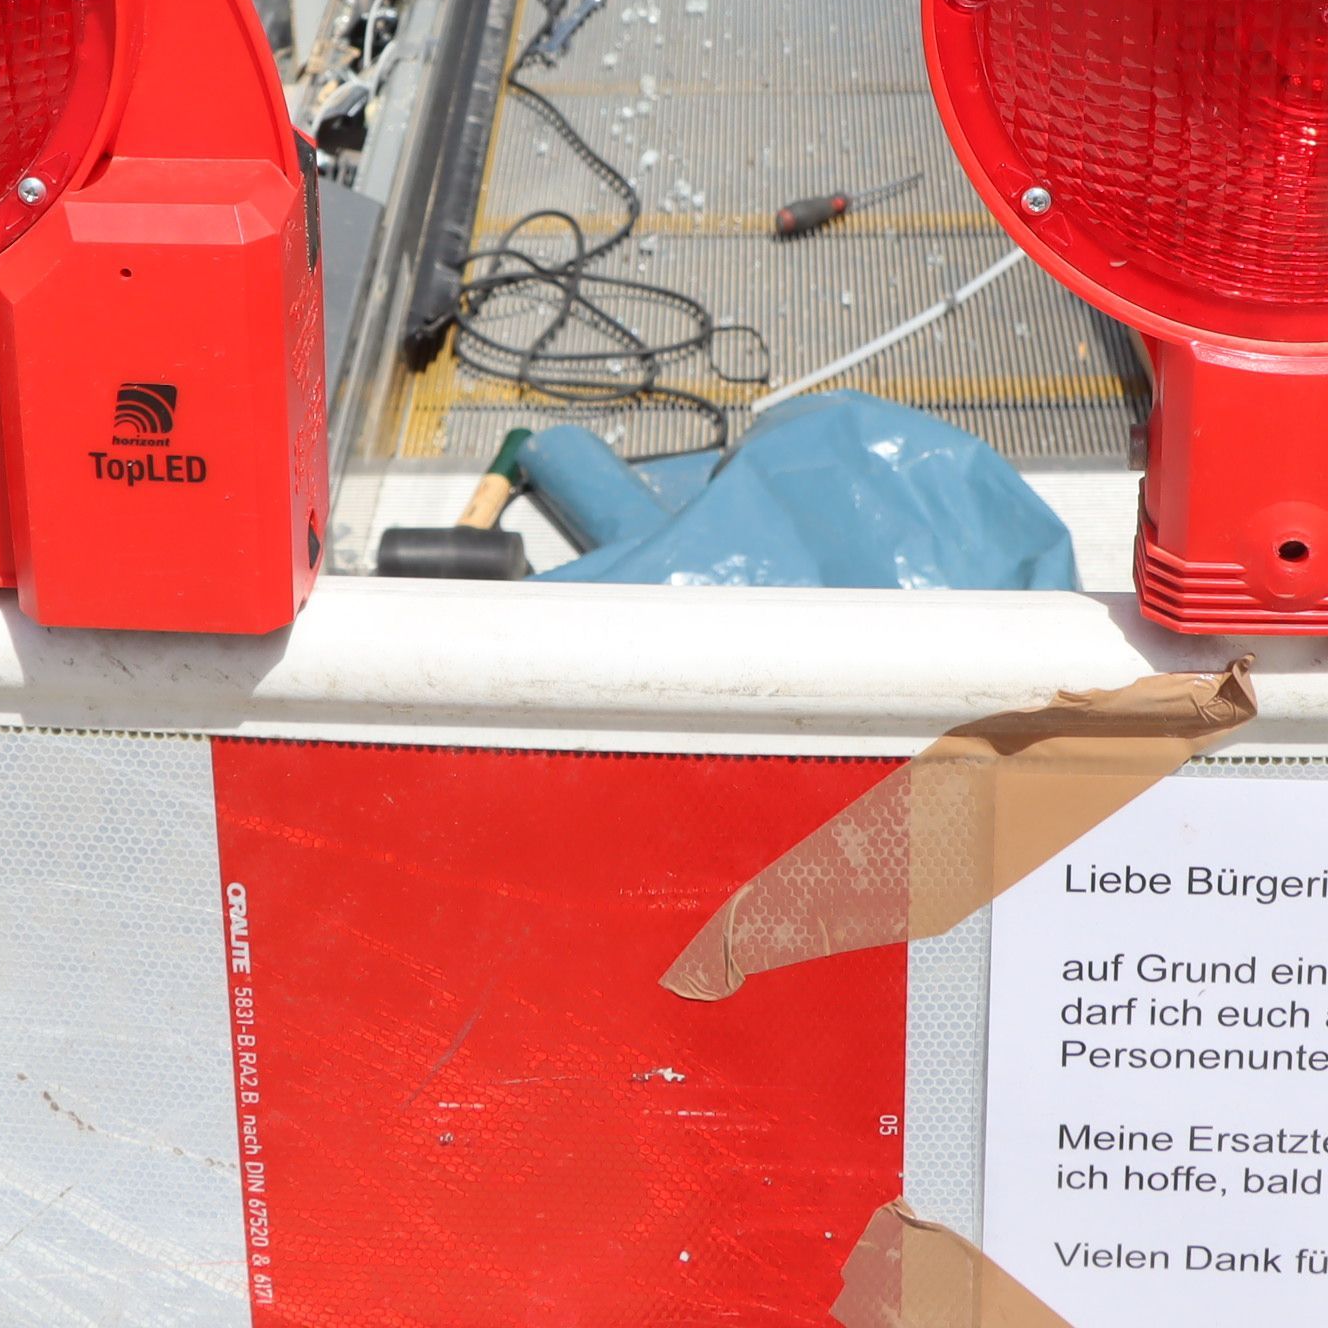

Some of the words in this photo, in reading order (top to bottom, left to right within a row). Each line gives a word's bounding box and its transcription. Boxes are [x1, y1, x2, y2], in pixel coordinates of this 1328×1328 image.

[112, 434, 170, 447] horizont
[88, 451, 207, 487] TopLED
[1064, 864, 1172, 895] Liebe
[1062, 953, 1125, 982] auf
[1136, 953, 1256, 984] Grund
[1060, 997, 1138, 1026] darf
[1150, 998, 1202, 1027] ich
[1217, 1000, 1310, 1028] euch
[242, 1114, 262, 1156] nach
[879, 1114, 899, 1136] 05
[1058, 1123, 1174, 1152] Meine
[246, 1162, 266, 1194] DIN
[1057, 1164, 1108, 1190] ich
[1124, 1165, 1227, 1197] hoffe,
[1243, 1167, 1322, 1195] bald
[247, 1197, 270, 1248] 67520
[252, 1253, 271, 1267] &
[1054, 1242, 1169, 1269] Vielen
[1185, 1245, 1282, 1273] Dank
[253, 1273, 275, 1305] 6171
